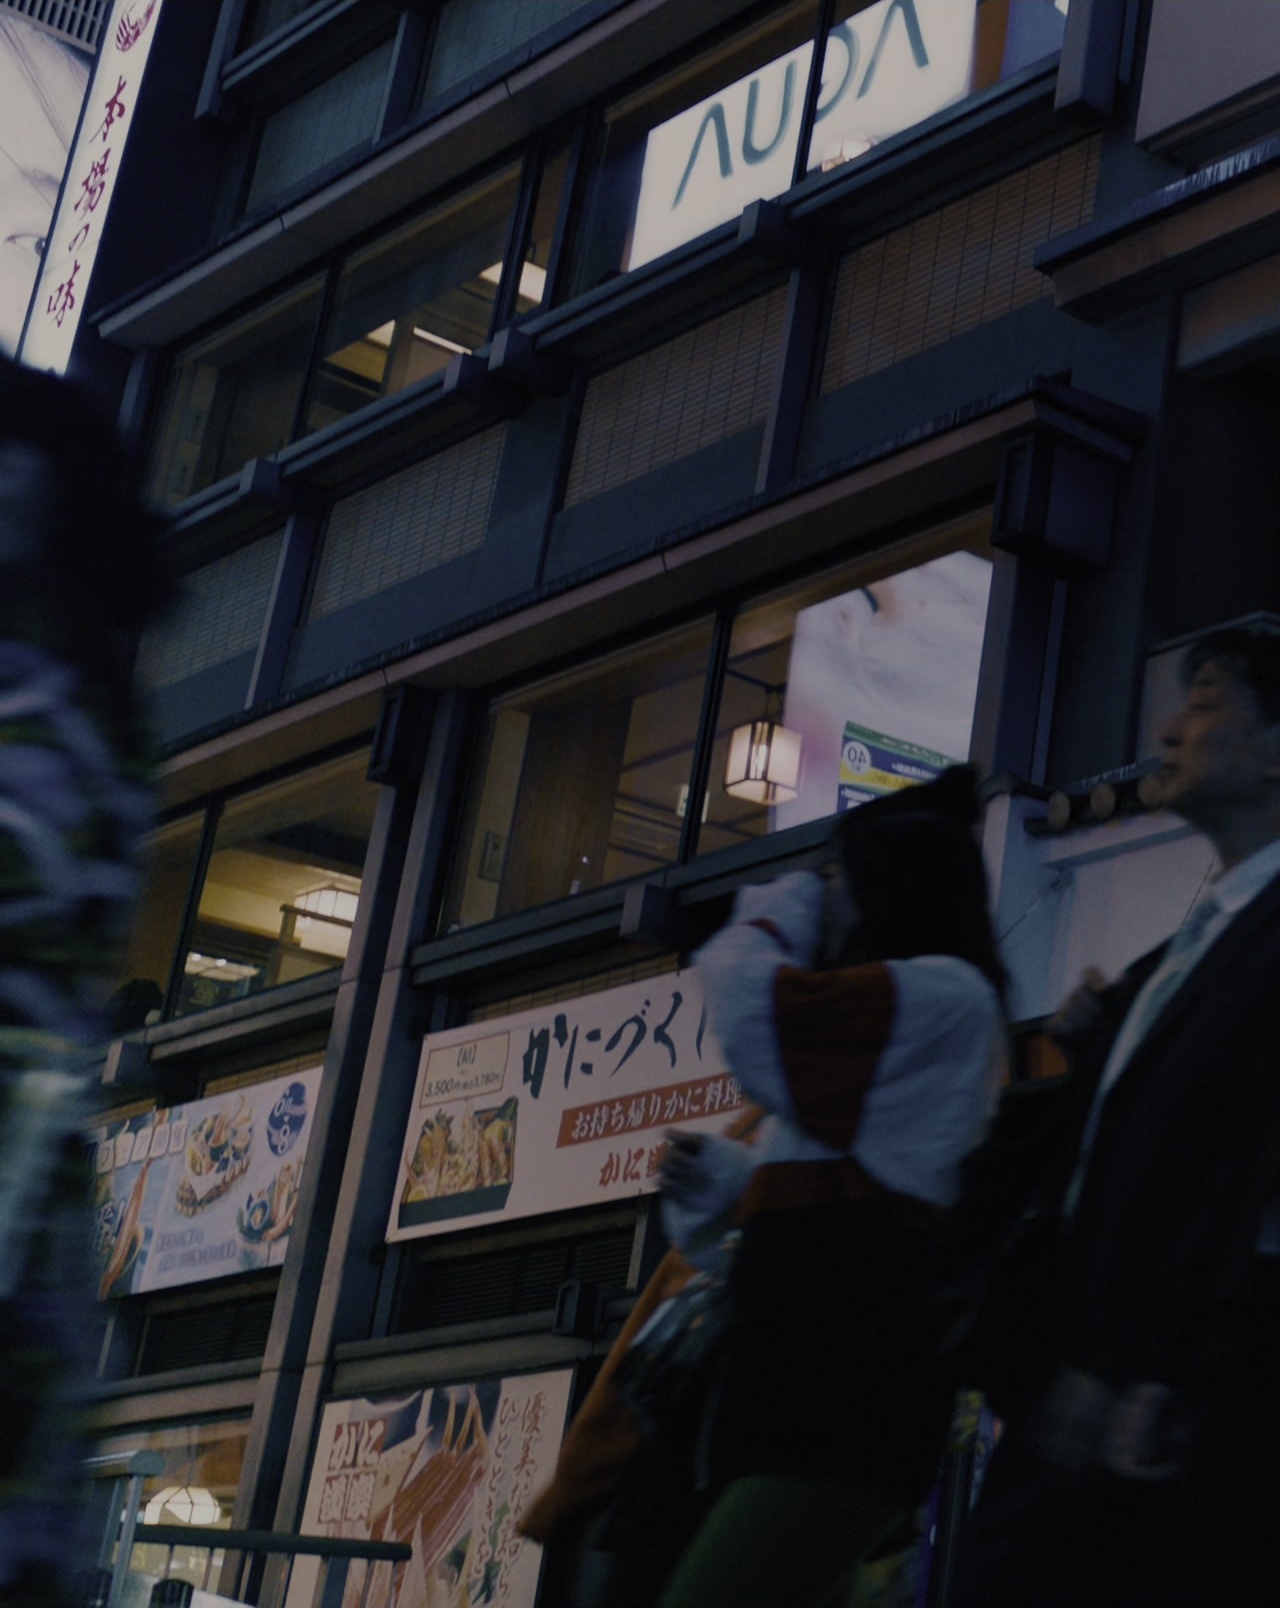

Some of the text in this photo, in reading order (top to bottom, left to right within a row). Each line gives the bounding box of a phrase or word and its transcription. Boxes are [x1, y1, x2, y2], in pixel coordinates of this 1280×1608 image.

[572, 1077, 741, 1140] お持ち帰りかに料理
